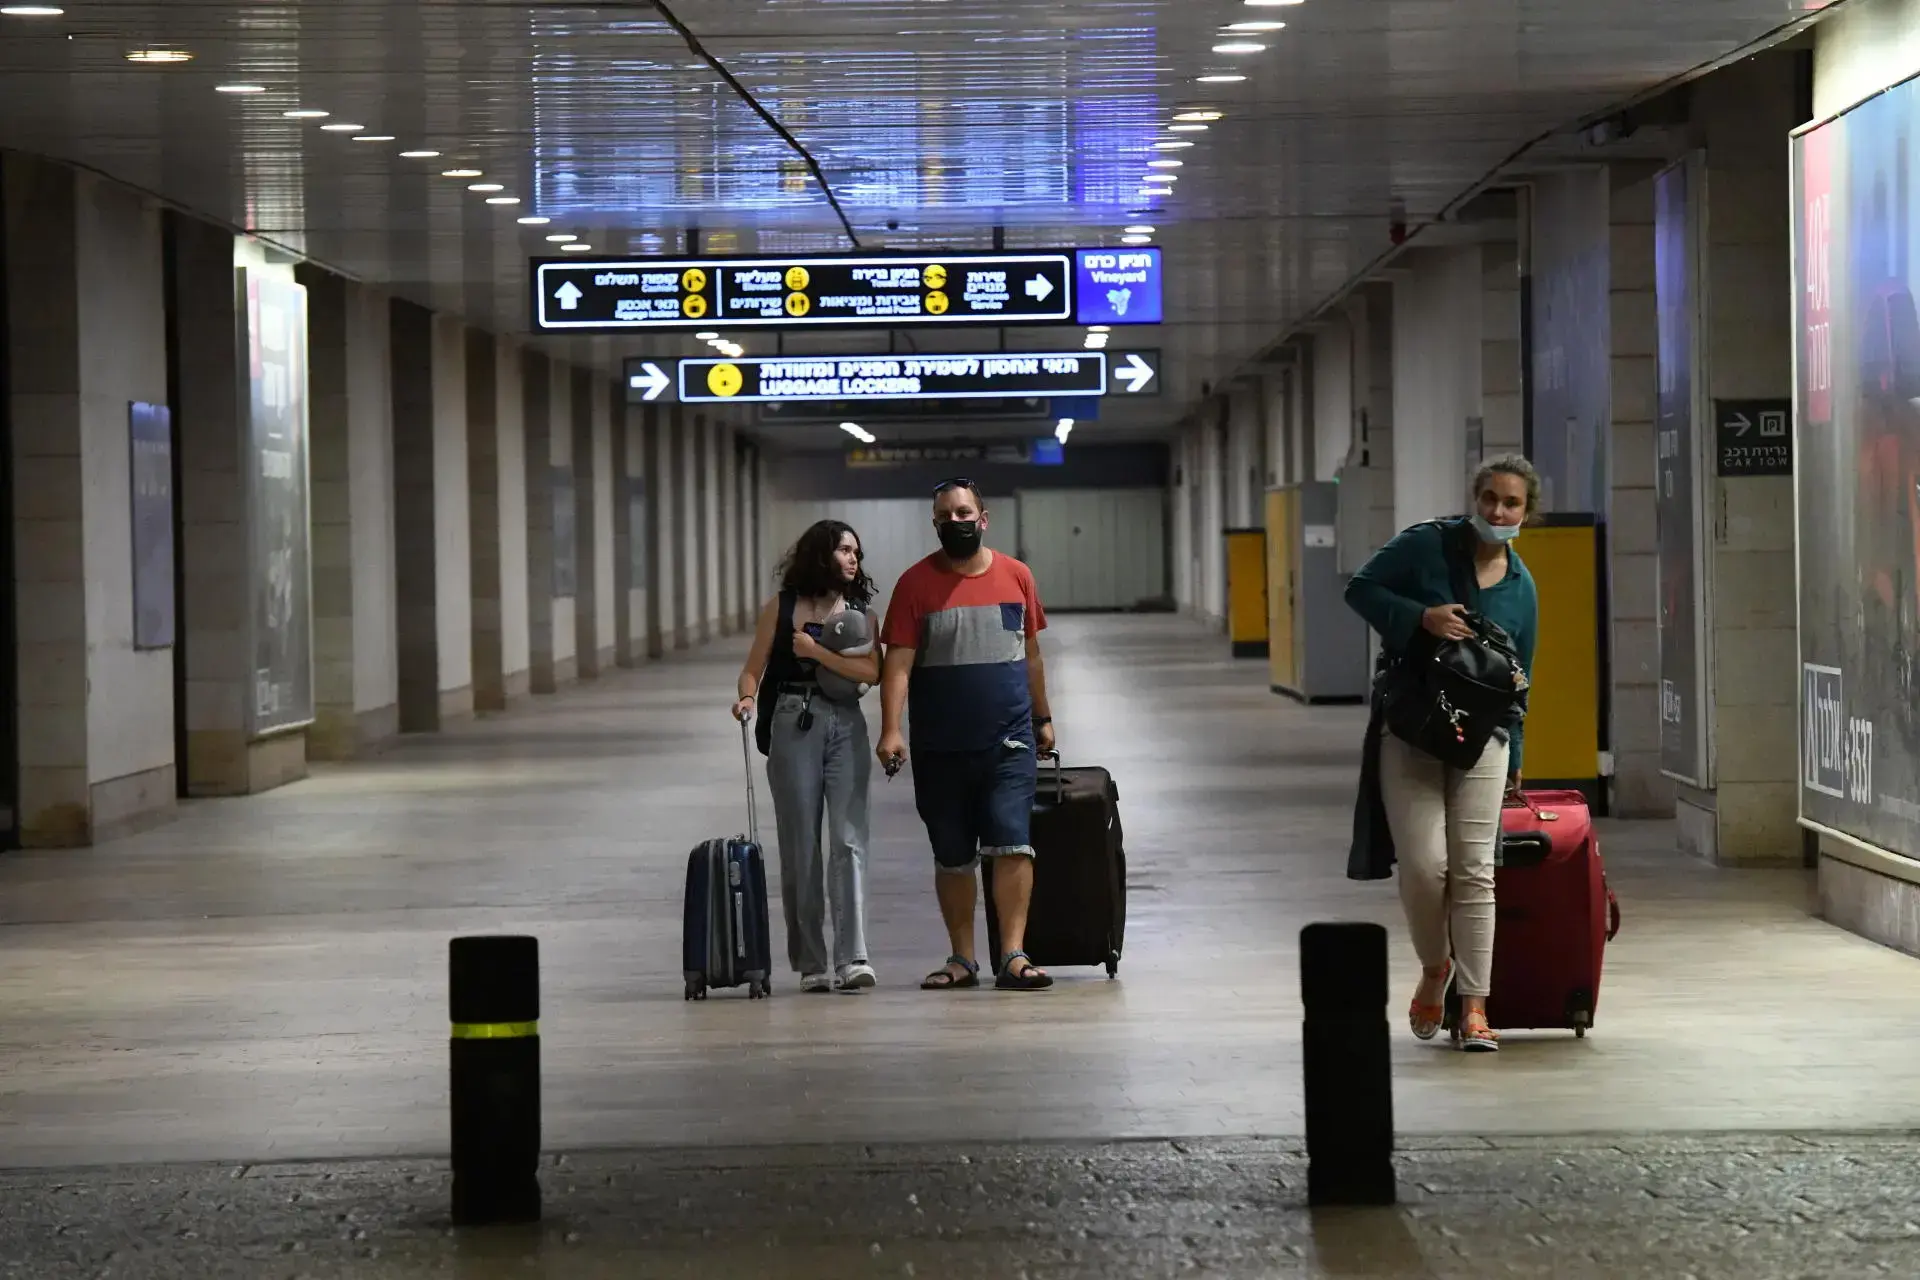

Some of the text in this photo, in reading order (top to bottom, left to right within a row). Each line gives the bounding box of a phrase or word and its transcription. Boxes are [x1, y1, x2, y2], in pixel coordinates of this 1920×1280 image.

[1119, 254, 1152, 270] חניון
[595, 272, 679, 286] קופות תשלום
[735, 270, 782, 283] מעליות
[890, 268, 919, 280] חניון
[967, 271, 1006, 282] שירות
[1091, 270, 1146, 285] Vineyard
[655, 299, 679, 309] תאי
[730, 298, 782, 309] שירותים
[819, 295, 920, 307] אבידות ומציאות
[856, 306, 875, 314] Lost
[877, 306, 892, 314] and
[760, 359, 1079, 378] תאי אחסון לשמירת חפצים ומזוודות
[760, 378, 921, 395] LUGGAGE LOCKERS
[1724, 446, 1788, 457] גרירת רכב
[1724, 457, 1788, 468] CAR TOW
